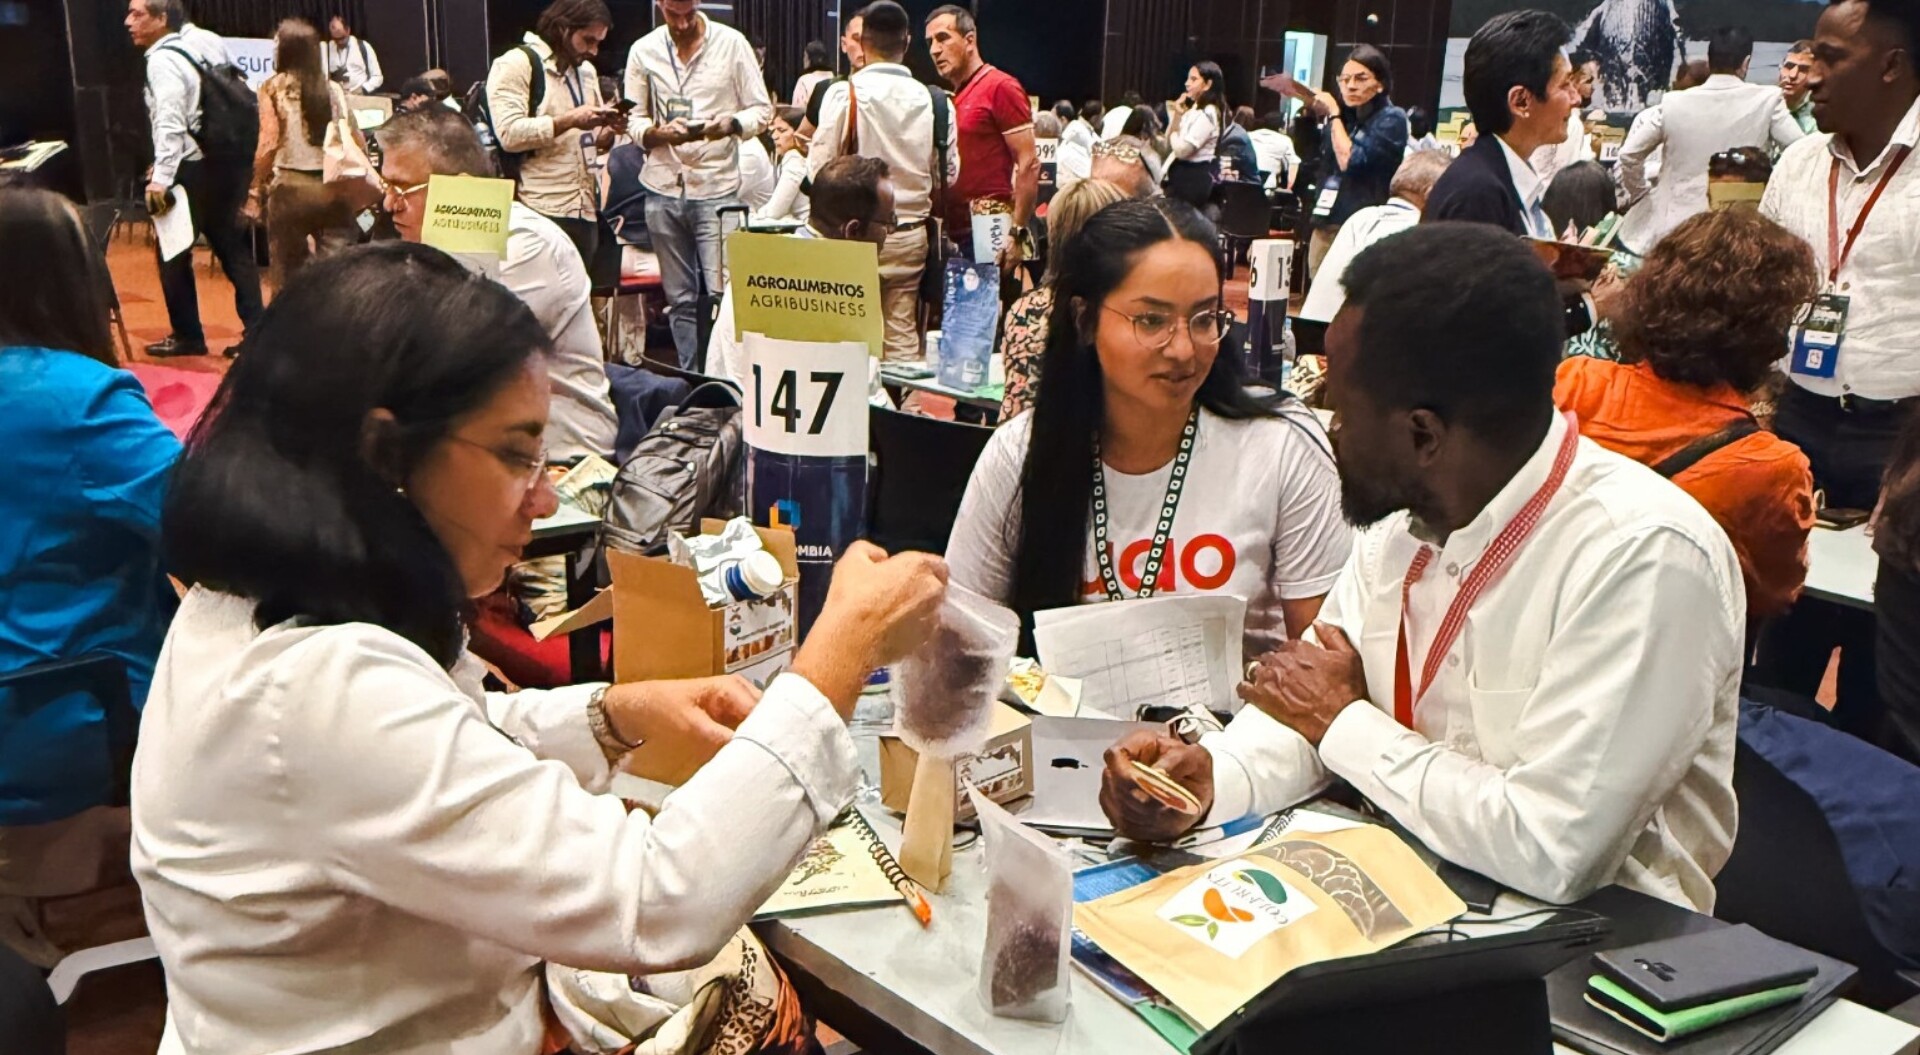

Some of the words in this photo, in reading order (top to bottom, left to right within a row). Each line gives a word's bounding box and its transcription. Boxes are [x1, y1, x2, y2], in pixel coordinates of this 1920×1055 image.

[237, 56, 275, 73] sur
[747, 275, 865, 298] AGROALIMENTOS
[750, 294, 866, 317] AGRIBUSINESS
[752, 363, 845, 435] 147
